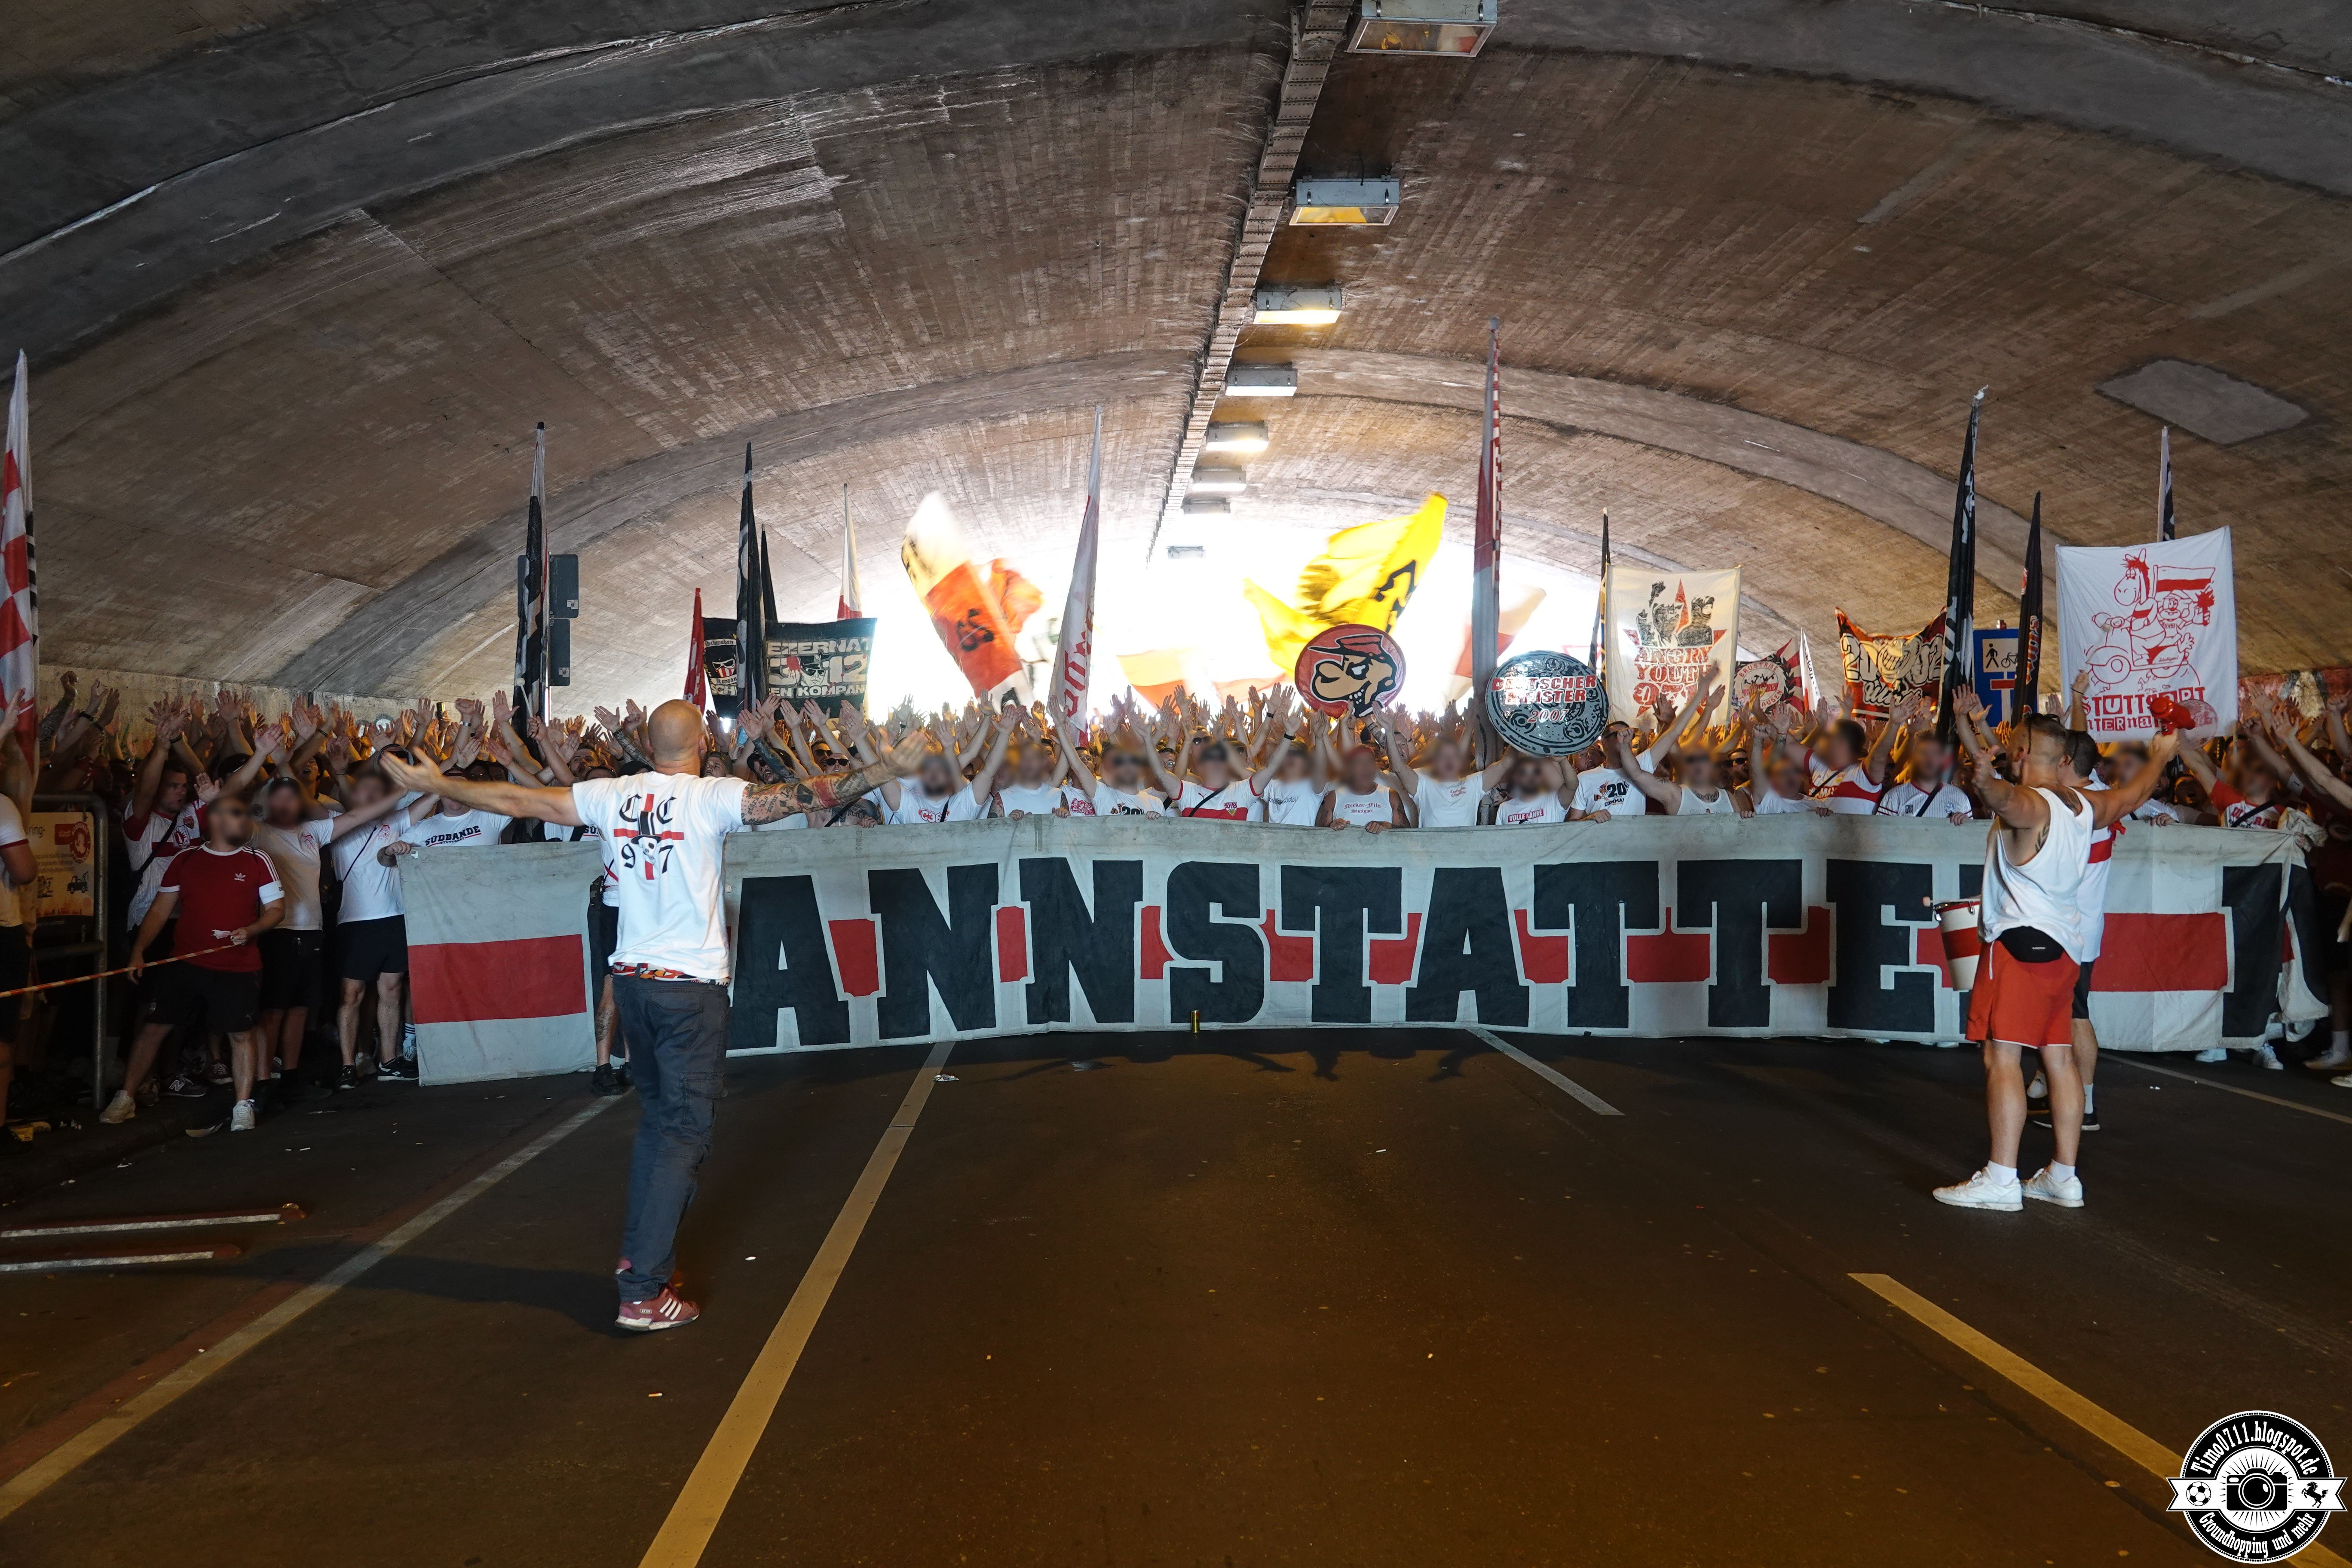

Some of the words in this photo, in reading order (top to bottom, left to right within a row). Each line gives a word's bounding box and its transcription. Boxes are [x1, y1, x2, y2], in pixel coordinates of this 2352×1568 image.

[705, 638, 733, 647] Schwaben
[767, 638, 870, 655] EZERNAT
[1634, 646, 1712, 664] ANGRY
[1528, 709, 1570, 723] 2007
[1509, 814, 1525, 822] VOLLE
[726, 858, 1984, 1050] ANNSTATTE
